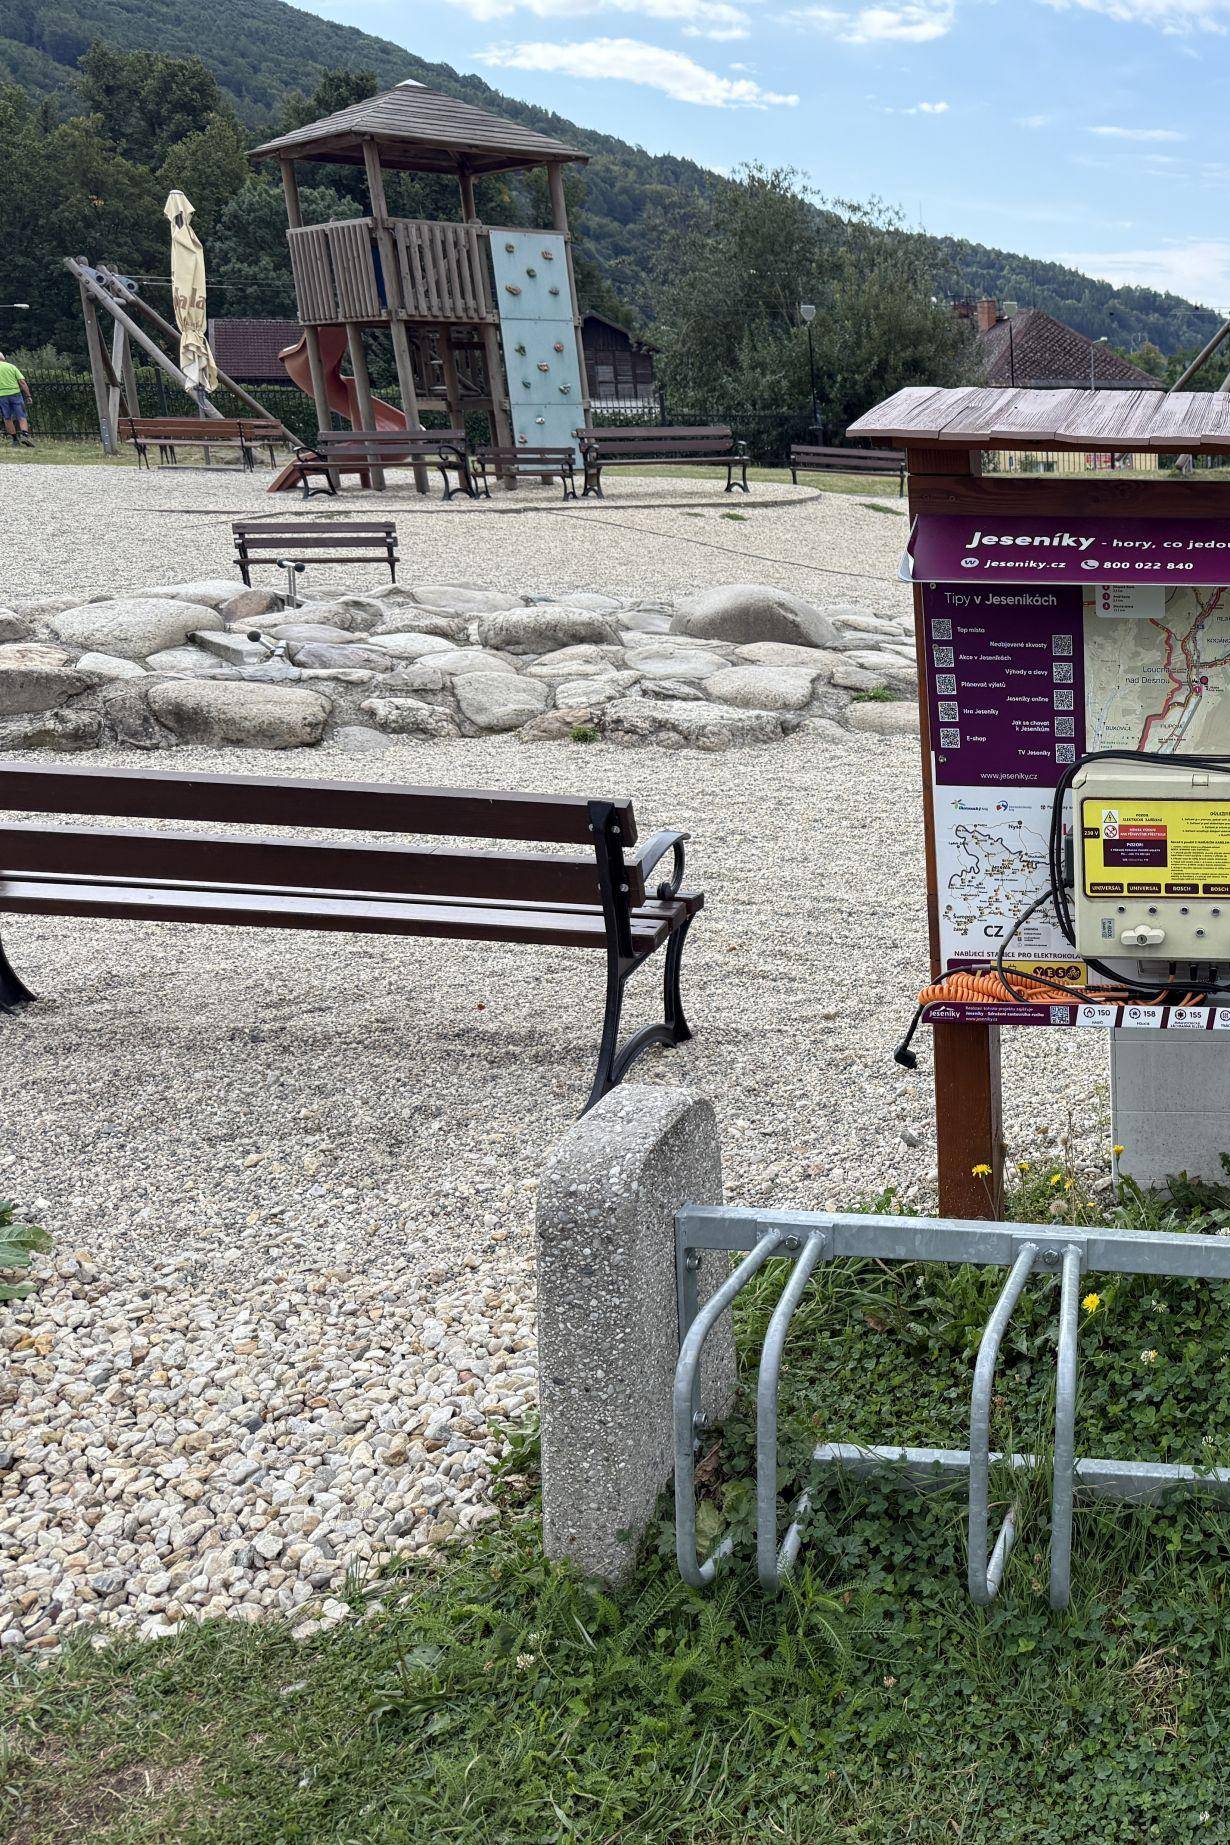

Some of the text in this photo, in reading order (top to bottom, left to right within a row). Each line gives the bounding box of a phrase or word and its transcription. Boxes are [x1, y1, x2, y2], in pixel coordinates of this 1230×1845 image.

[966, 531, 1095, 550] Jeseníky
[1112, 539, 1155, 549] hory,
[983, 559, 1066, 569] jeseniky.cz
[1103, 561, 1194, 570] 800 022 840
[944, 592, 1057, 606] Tipy v Jeseníkách
[984, 925, 1004, 938] CZ
[954, 949, 985, 958] NABÍJECÍ
[929, 1009, 961, 1018] Jeseníky
